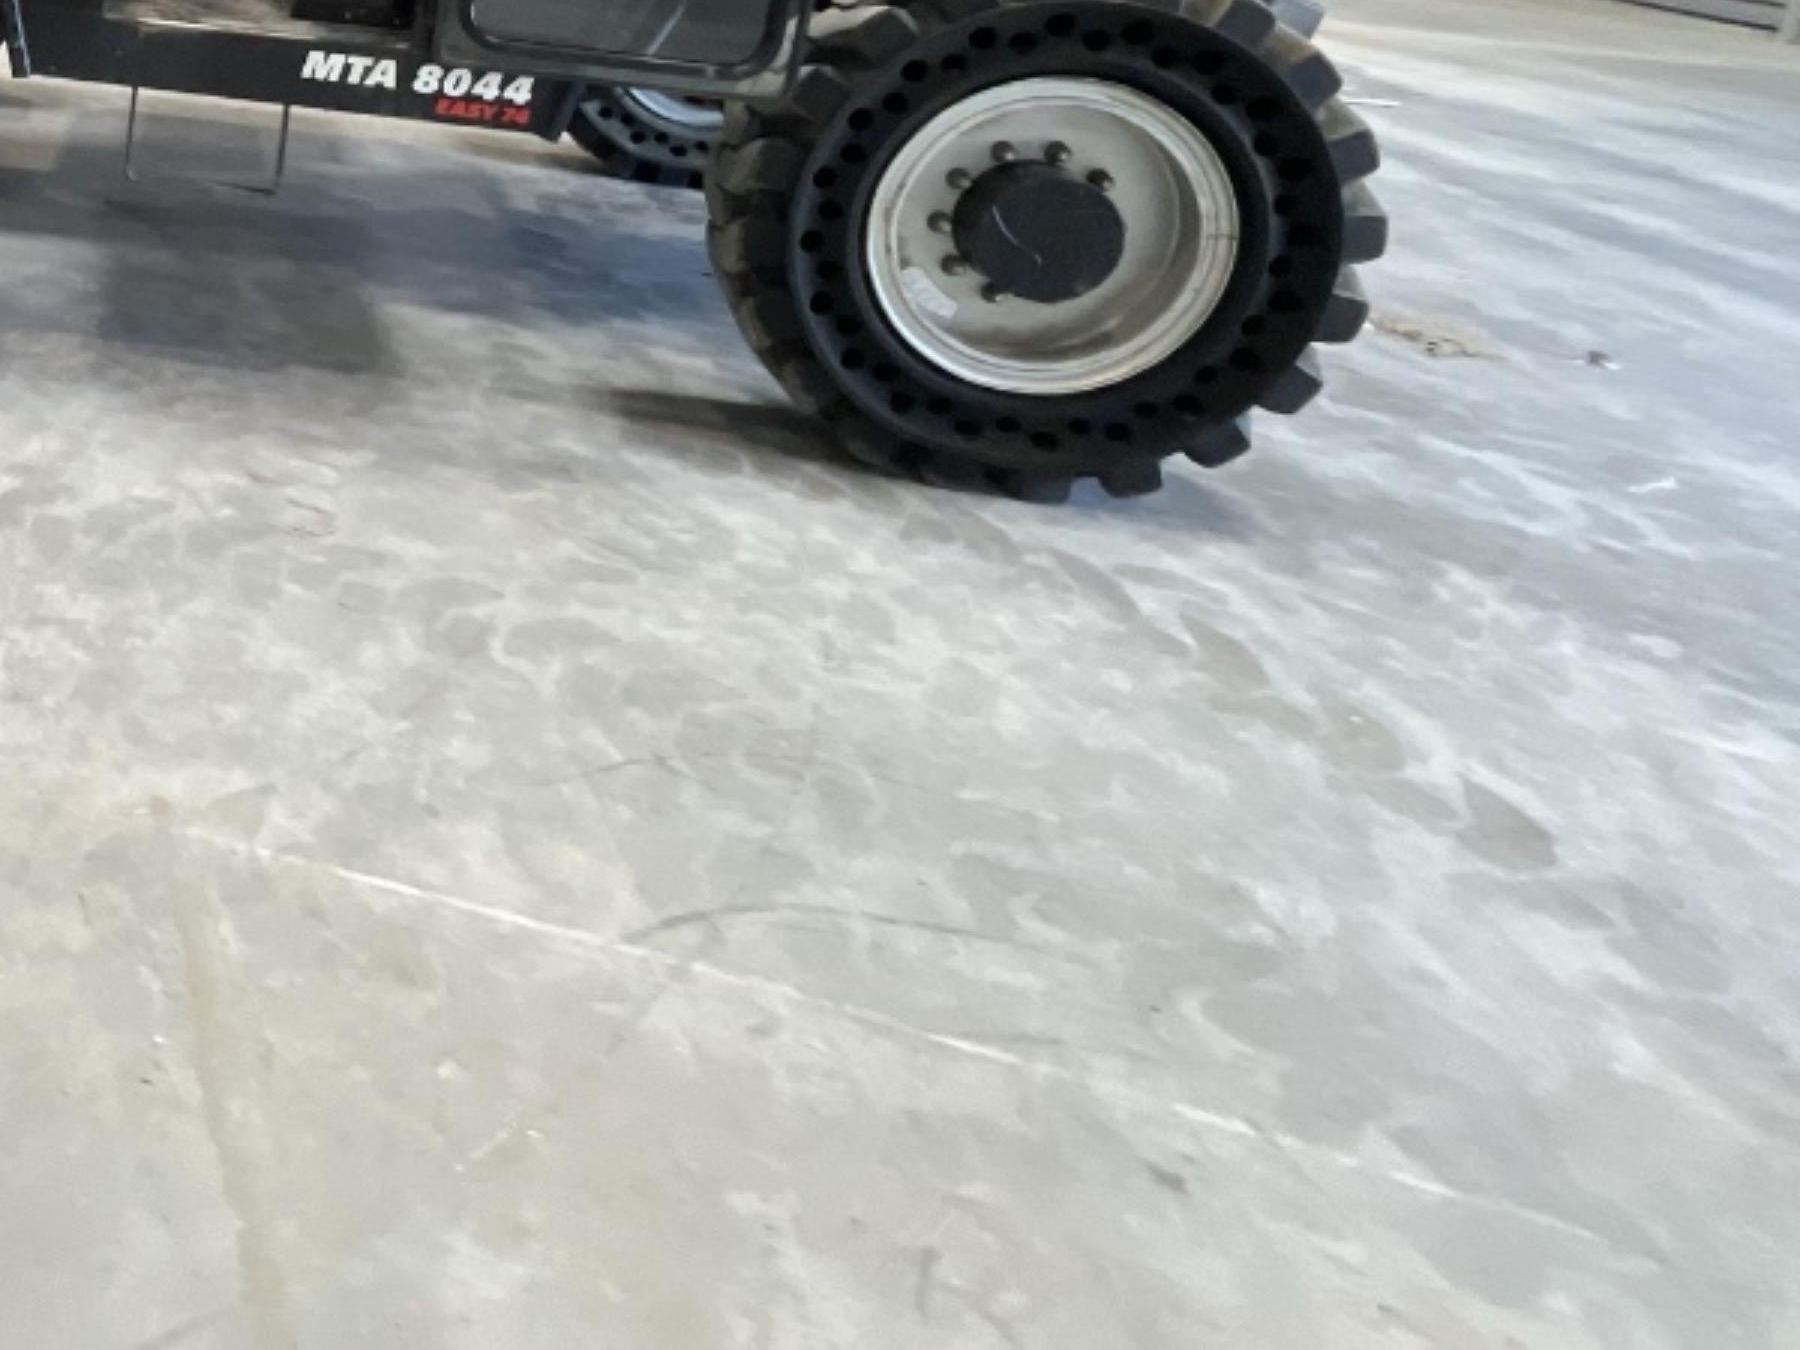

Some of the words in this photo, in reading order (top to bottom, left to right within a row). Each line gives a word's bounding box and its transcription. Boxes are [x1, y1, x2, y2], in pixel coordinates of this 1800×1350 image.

[301, 50, 397, 90] MTA
[412, 64, 535, 105] 8044
[434, 97, 498, 120] EASY
